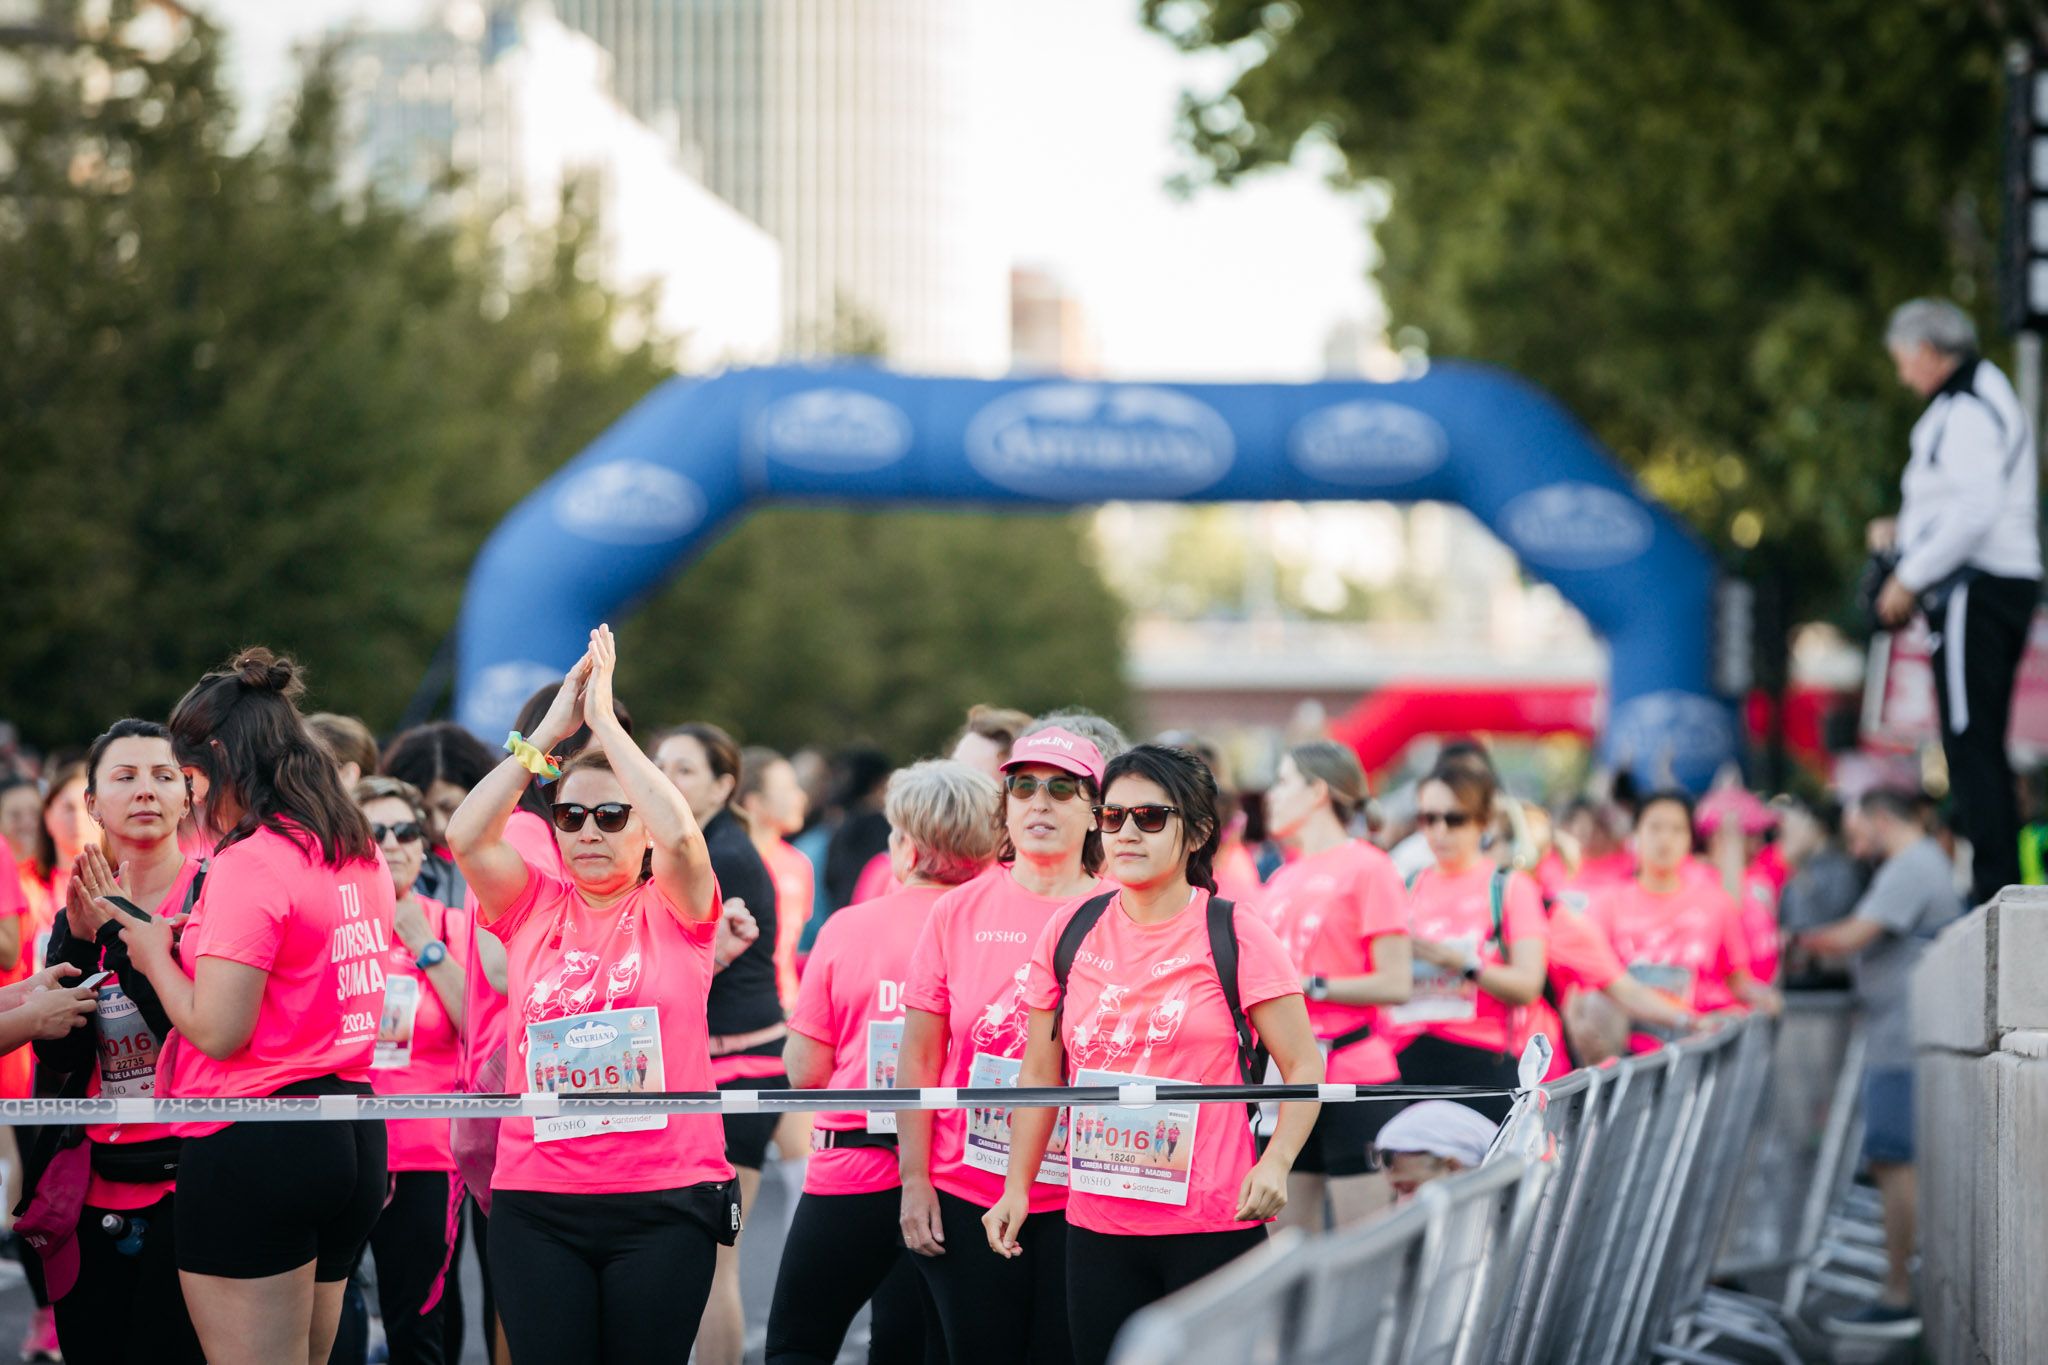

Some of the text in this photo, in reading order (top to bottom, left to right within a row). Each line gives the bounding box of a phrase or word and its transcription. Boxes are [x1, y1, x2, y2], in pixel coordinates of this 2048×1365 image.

[339, 883, 361, 919] TU
[331, 918, 388, 963] DORSAL
[975, 930, 1028, 944] OYSHO
[337, 958, 385, 1001] SUMA
[101, 1002, 136, 1015] STURIAN
[341, 1011, 376, 1033] 2024
[107, 1032, 152, 1057] 016
[568, 1030, 615, 1044] ASTURIANA
[116, 1057, 145, 1070] 22735
[122, 1070, 131, 1078] LA
[131, 1066, 153, 1076] MUJER
[570, 1065, 620, 1089] 016
[547, 1115, 652, 1133] OYSHO Santander
[1105, 1127, 1150, 1150] 016
[1110, 1152, 1136, 1164] 18240
[1039, 1167, 1068, 1178] antande
[1080, 1160, 1103, 1170] CARRERA
[1103, 1163, 1111, 1171] DE
[1111, 1163, 1119, 1172] LA
[1120, 1164, 1140, 1174] MUJER
[1145, 1168, 1172, 1179] MADRID
[1079, 1174, 1172, 1196] OYSHO Santander
